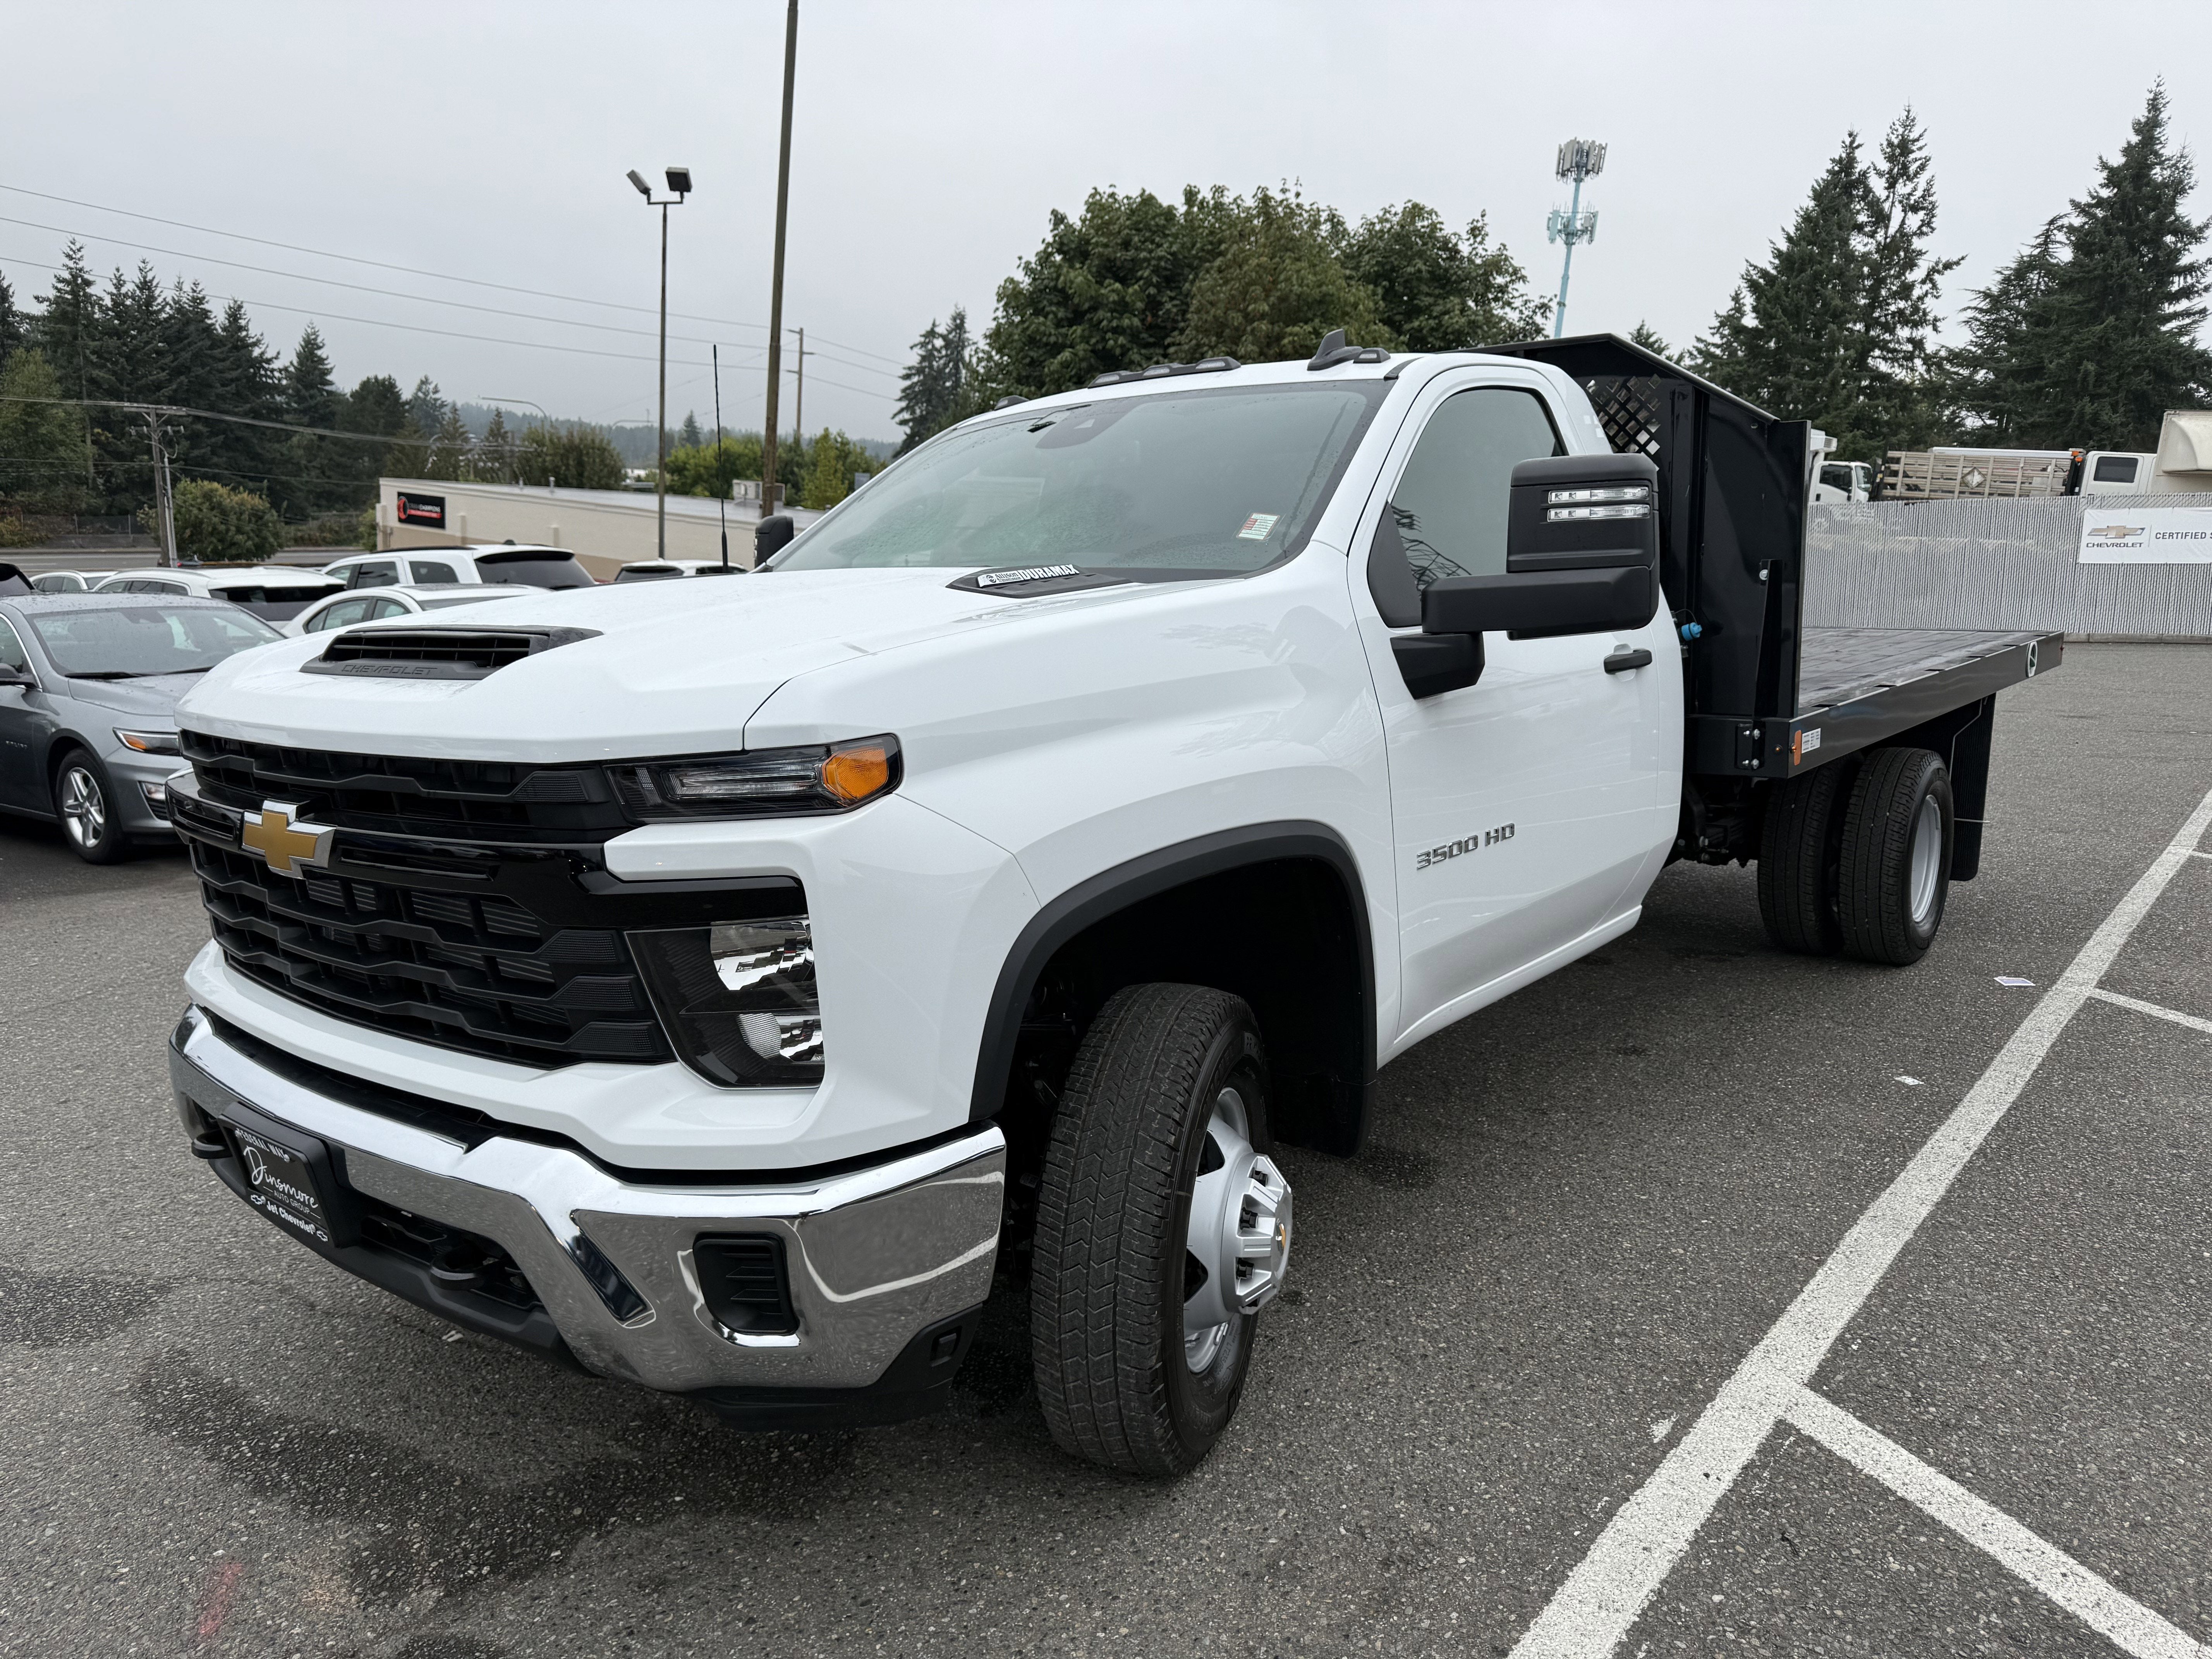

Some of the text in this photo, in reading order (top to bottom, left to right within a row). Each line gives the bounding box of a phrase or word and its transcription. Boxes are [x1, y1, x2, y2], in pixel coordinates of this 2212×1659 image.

[1018, 564, 1080, 581] DURAMAX
[342, 665, 438, 675] CHEVROLET
[1417, 823, 1515, 871] 3500 HD
[243, 1145, 318, 1209] Dinsmore
[274, 1190, 310, 1214] AUTO GROUP
[266, 1200, 314, 1235] Jet Chevrolet
